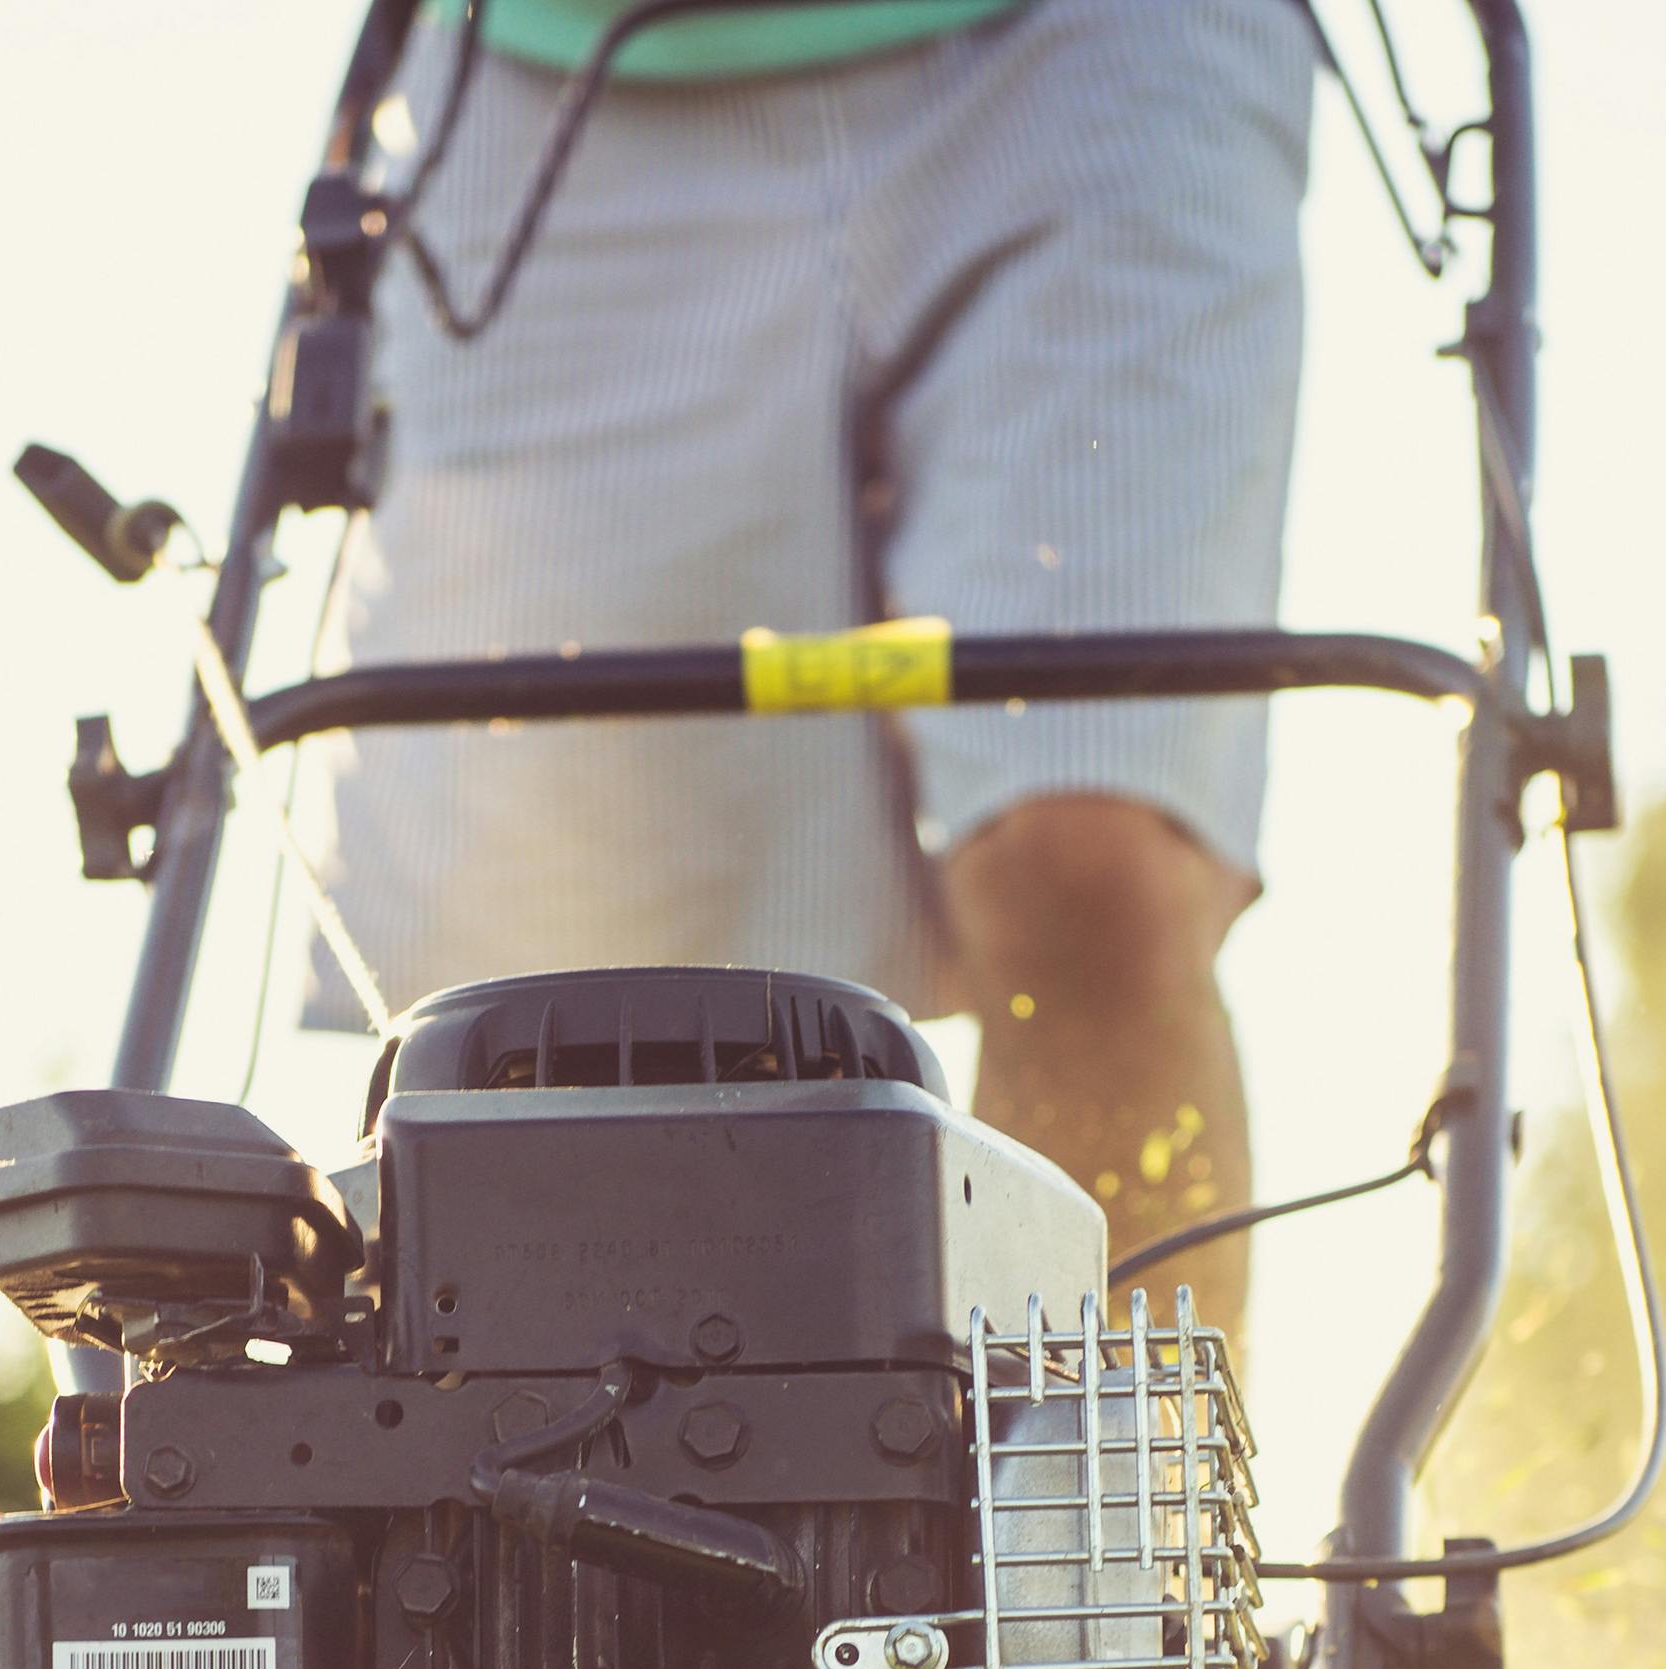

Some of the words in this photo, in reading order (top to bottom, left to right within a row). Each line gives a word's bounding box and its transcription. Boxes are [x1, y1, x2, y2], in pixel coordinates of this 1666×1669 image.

[111, 1622, 127, 1638] 10
[132, 1621, 163, 1638] 1020
[186, 1620, 226, 1636] 90306
